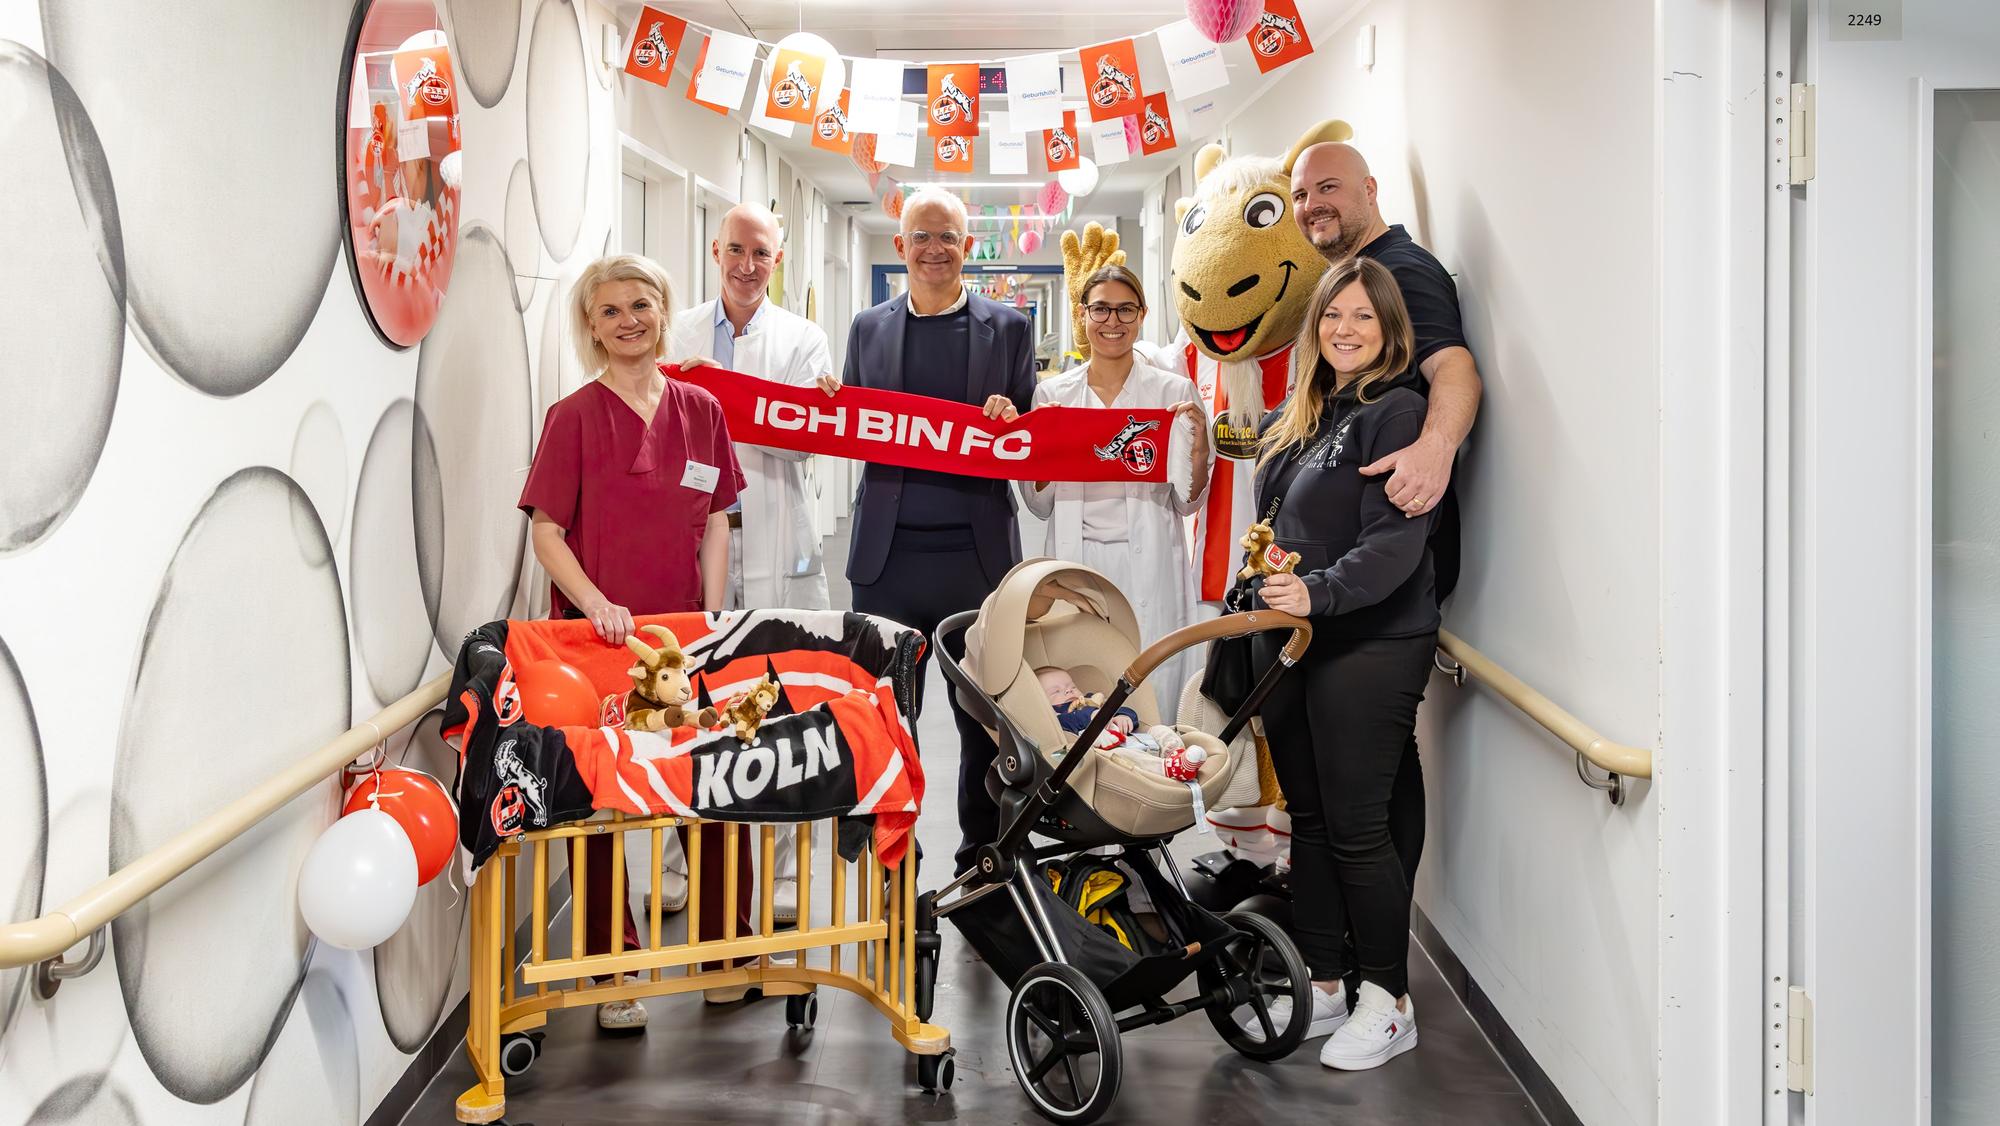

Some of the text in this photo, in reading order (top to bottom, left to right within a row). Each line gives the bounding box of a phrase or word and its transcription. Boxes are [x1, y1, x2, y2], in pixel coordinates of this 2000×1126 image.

[1847, 14, 1882, 26] 2249
[754, 396, 1032, 461] ICH BIN FC
[697, 721, 842, 809] KÖLN
